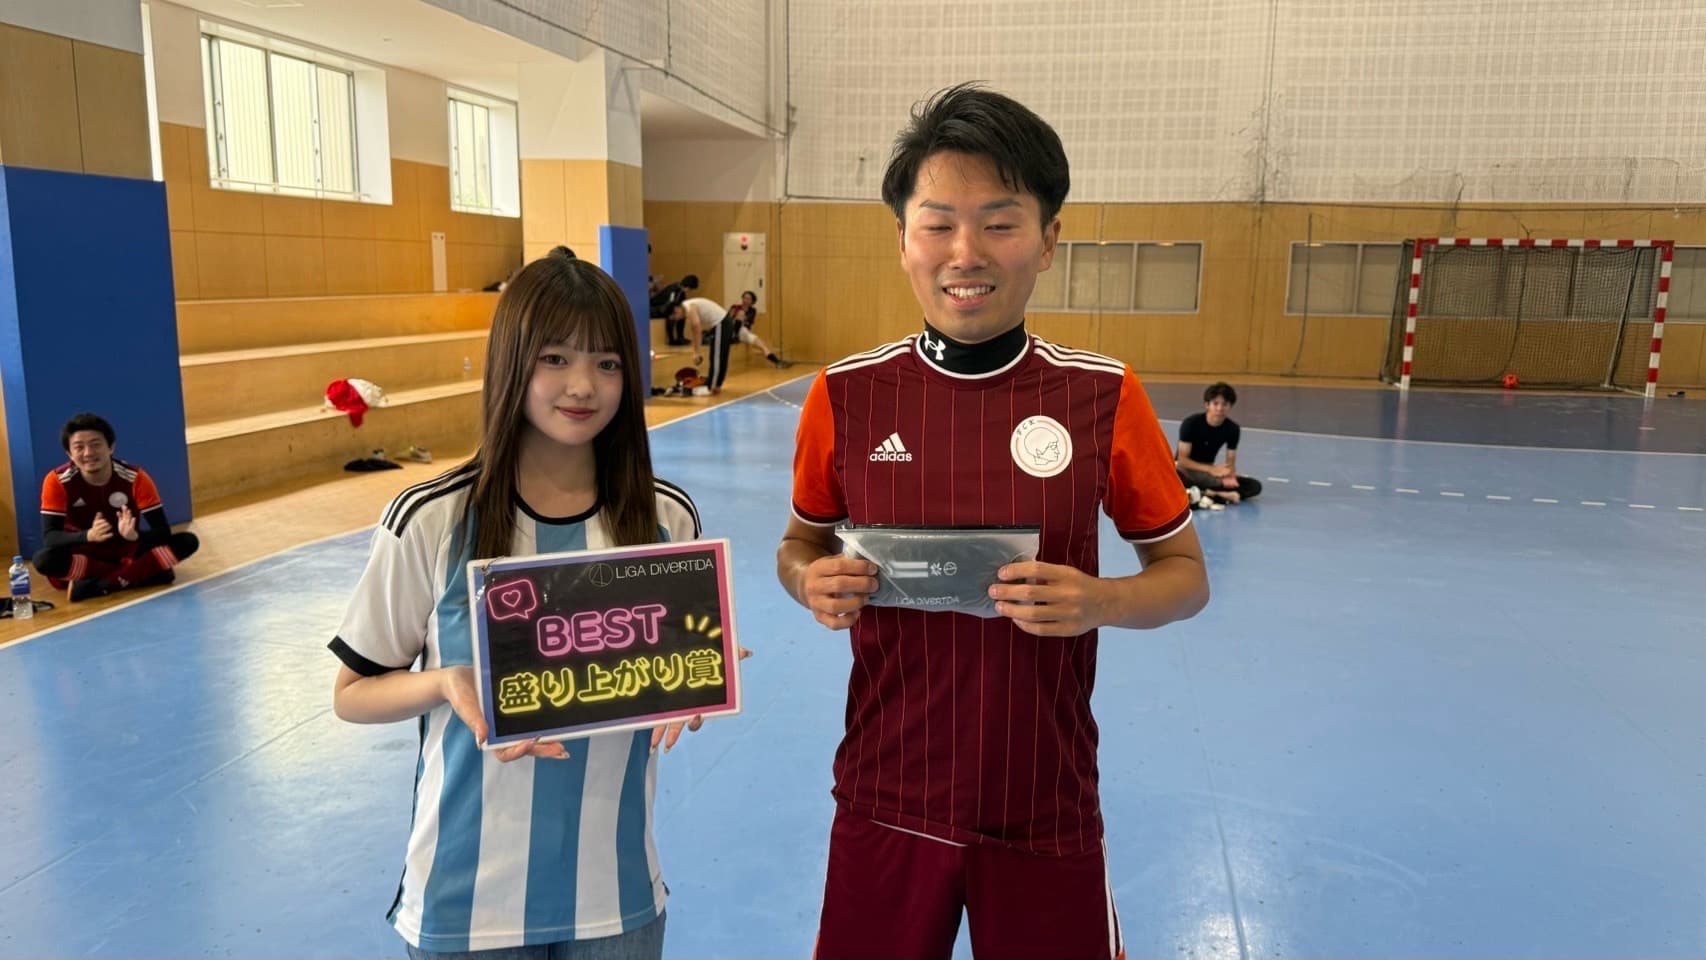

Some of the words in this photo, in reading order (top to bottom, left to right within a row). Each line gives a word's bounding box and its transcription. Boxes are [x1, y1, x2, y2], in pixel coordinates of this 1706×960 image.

[870, 450, 913, 462] adidas
[537, 604, 667, 656] BEST
[500, 649, 724, 714] 盛り上がり賞
